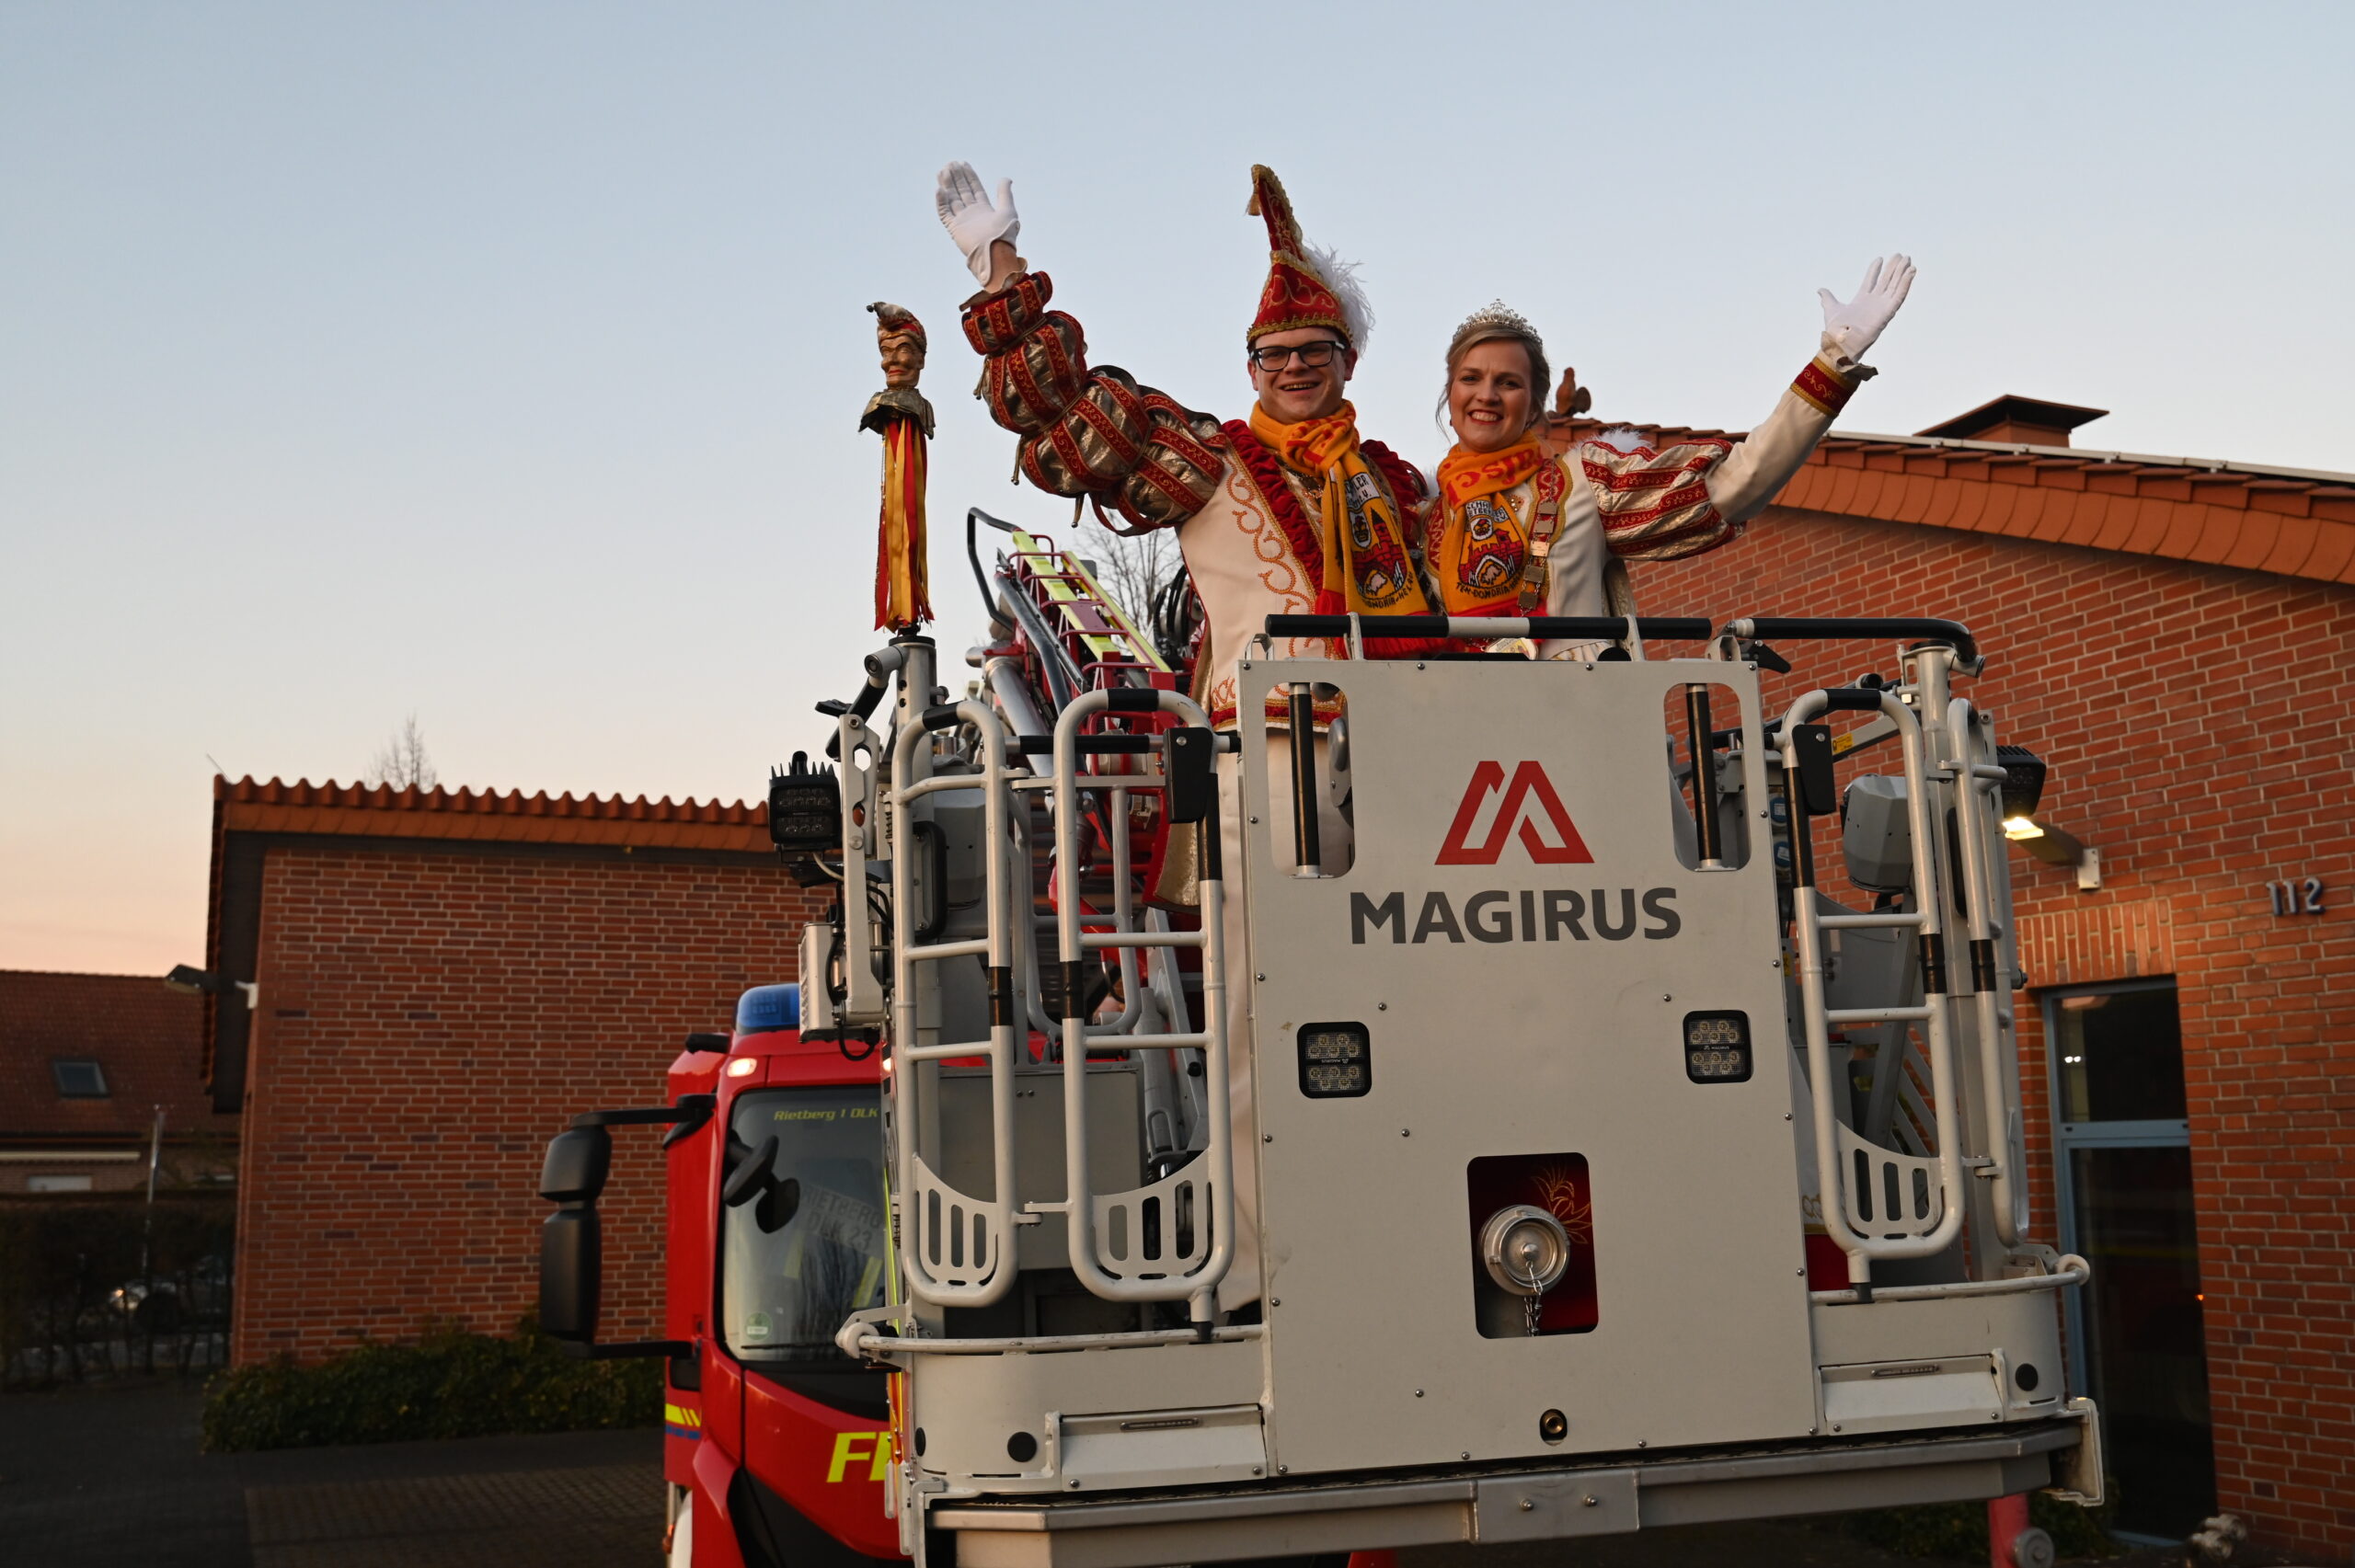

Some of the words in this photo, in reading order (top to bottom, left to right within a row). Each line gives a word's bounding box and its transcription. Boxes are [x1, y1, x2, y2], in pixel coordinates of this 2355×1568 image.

[2266, 877, 2325, 915] 112
[1350, 887, 1682, 944] MAGIRUS
[774, 1110, 836, 1121] Rietberg
